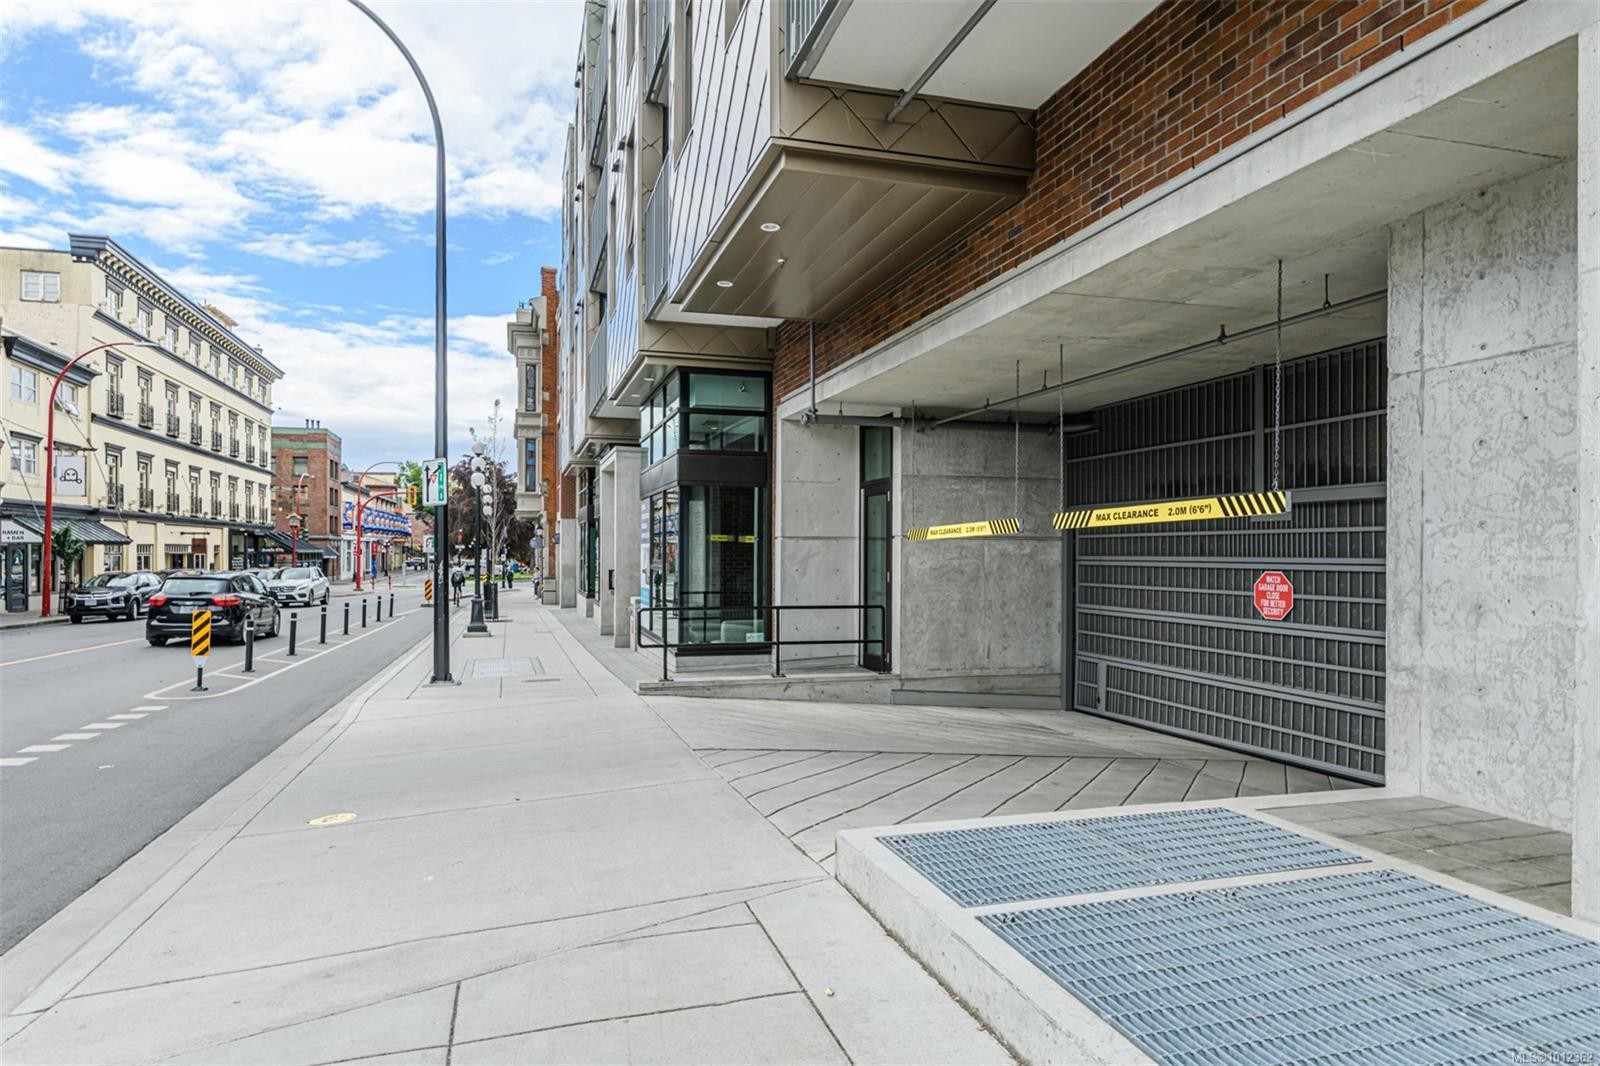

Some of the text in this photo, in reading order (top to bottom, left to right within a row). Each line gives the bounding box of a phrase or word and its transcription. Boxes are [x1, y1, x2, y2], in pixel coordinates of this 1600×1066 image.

[1095, 512, 1111, 522] MAX
[1113, 508, 1159, 520] CLEARANCE
[1167, 506, 1187, 517] 2.0M
[939, 527, 962, 535] CLEARANCE
[1258, 583, 1289, 592] GARAGE DOOR
[1266, 592, 1280, 600] CLOSE
[1260, 599, 1286, 608] FOR BETTER
[1263, 607, 1284, 615] SECURITY
